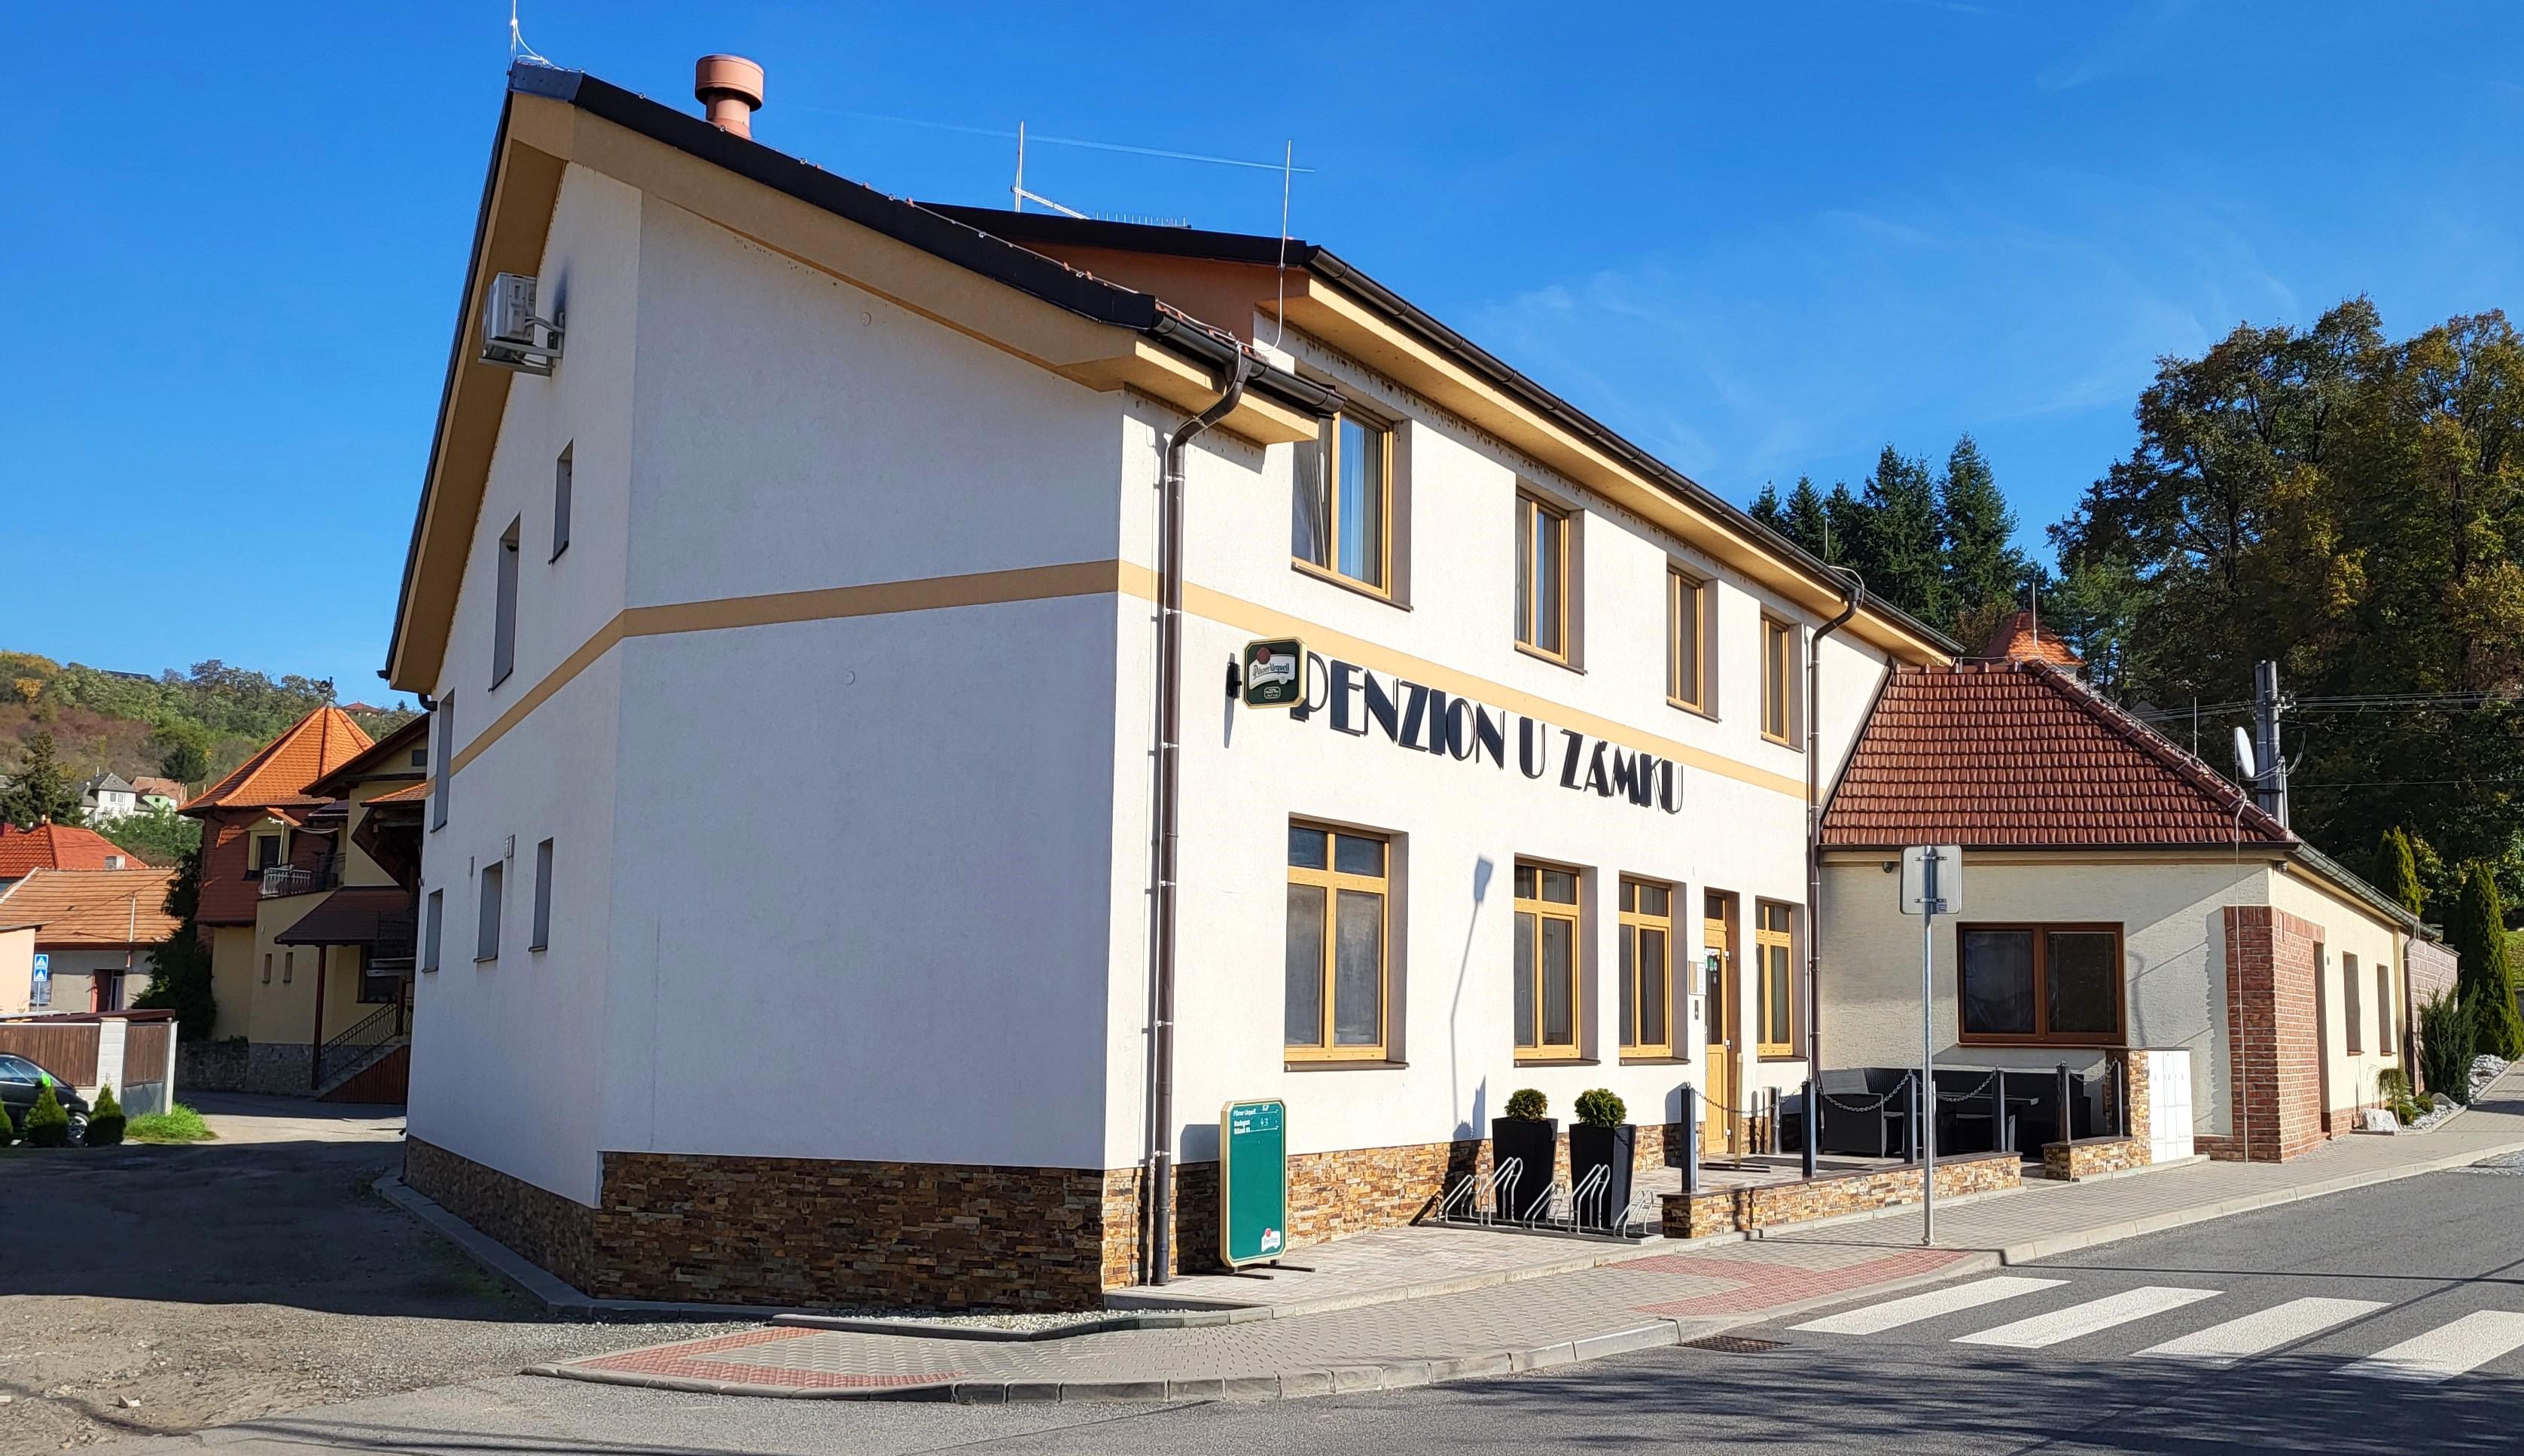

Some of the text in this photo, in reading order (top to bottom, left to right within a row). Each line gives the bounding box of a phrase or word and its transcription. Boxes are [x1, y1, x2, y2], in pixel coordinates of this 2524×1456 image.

[1253, 663, 1289, 680] Pilsner Urquell
[1290, 650, 1684, 815] PENZION U ZÁMKU
